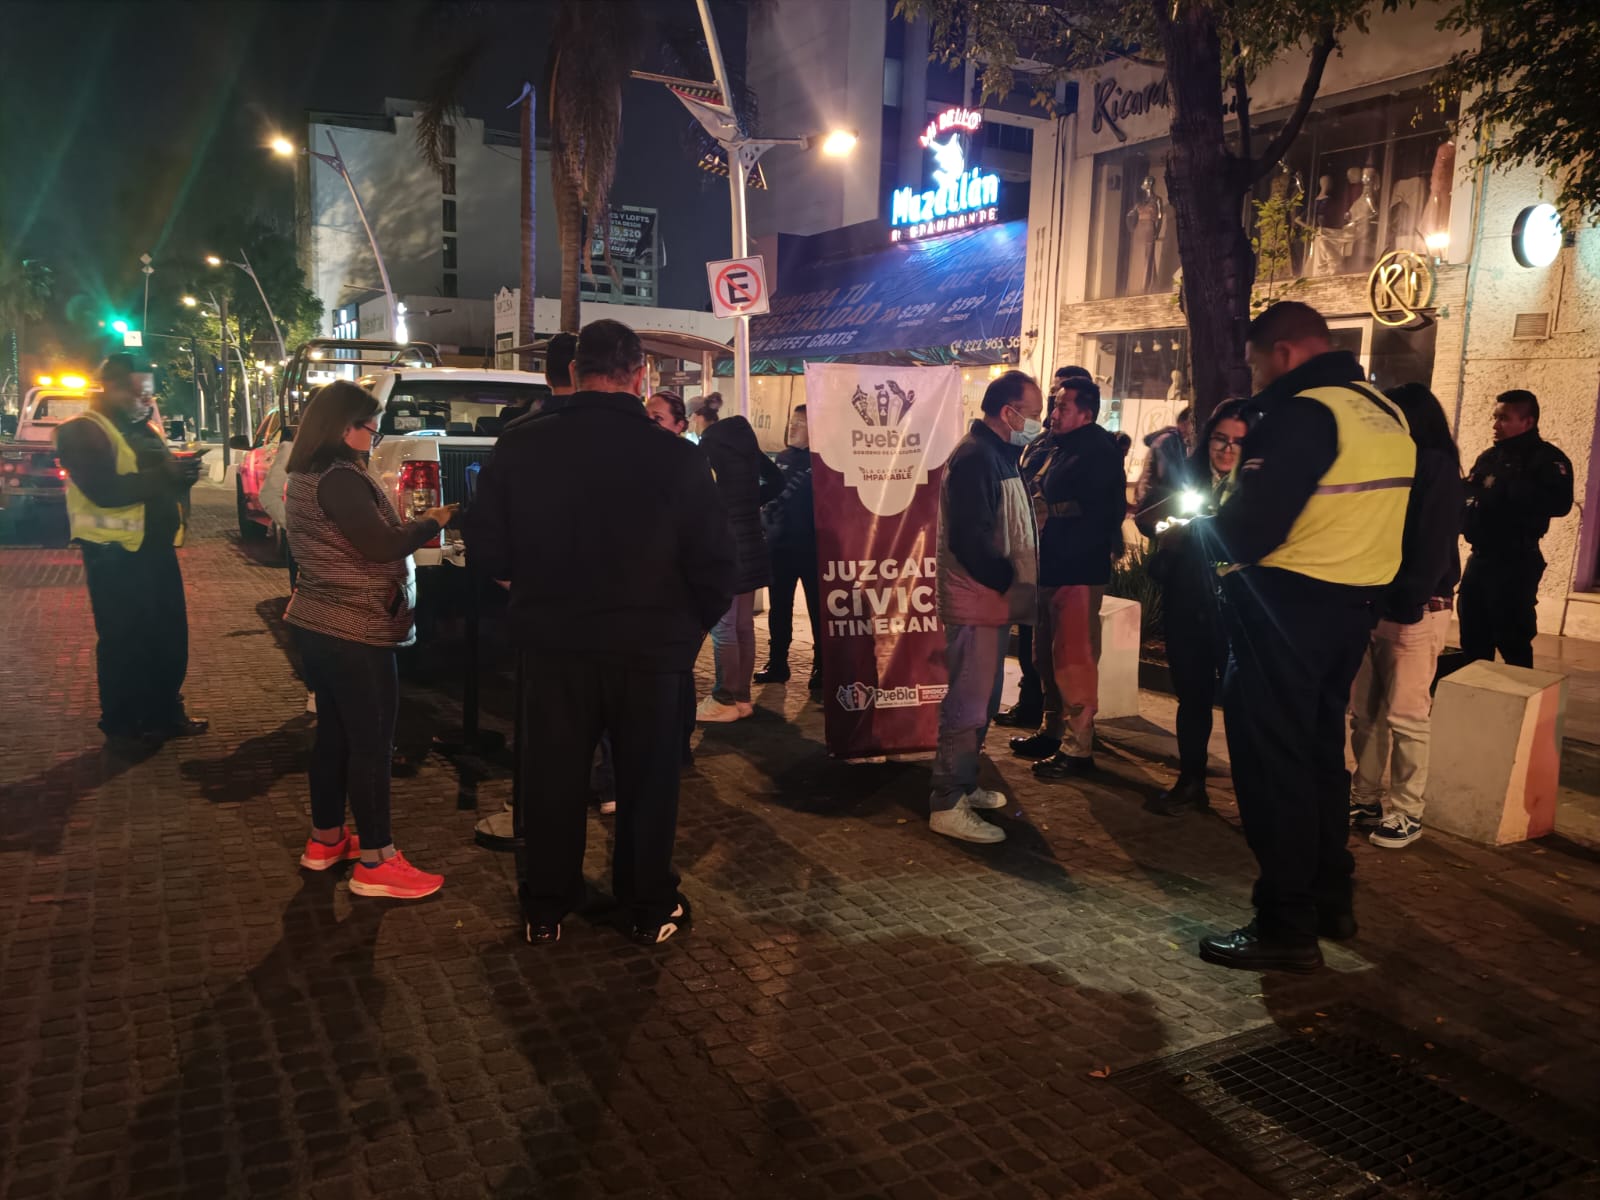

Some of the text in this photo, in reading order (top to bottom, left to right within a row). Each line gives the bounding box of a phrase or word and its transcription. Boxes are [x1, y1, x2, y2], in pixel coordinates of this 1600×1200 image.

[1091, 77, 1170, 142] Ricard
[891, 207, 998, 241] RSTAURANTE
[726, 271, 752, 304] E
[807, 330, 858, 348] GRATIS
[852, 430, 921, 448] Puebla
[863, 472, 913, 481] IMPARABLE
[823, 557, 936, 582] JUZGAD
[826, 581, 935, 617] CÍVIC
[828, 616, 945, 637] ITINERAN
[875, 688, 917, 701] Puebla
